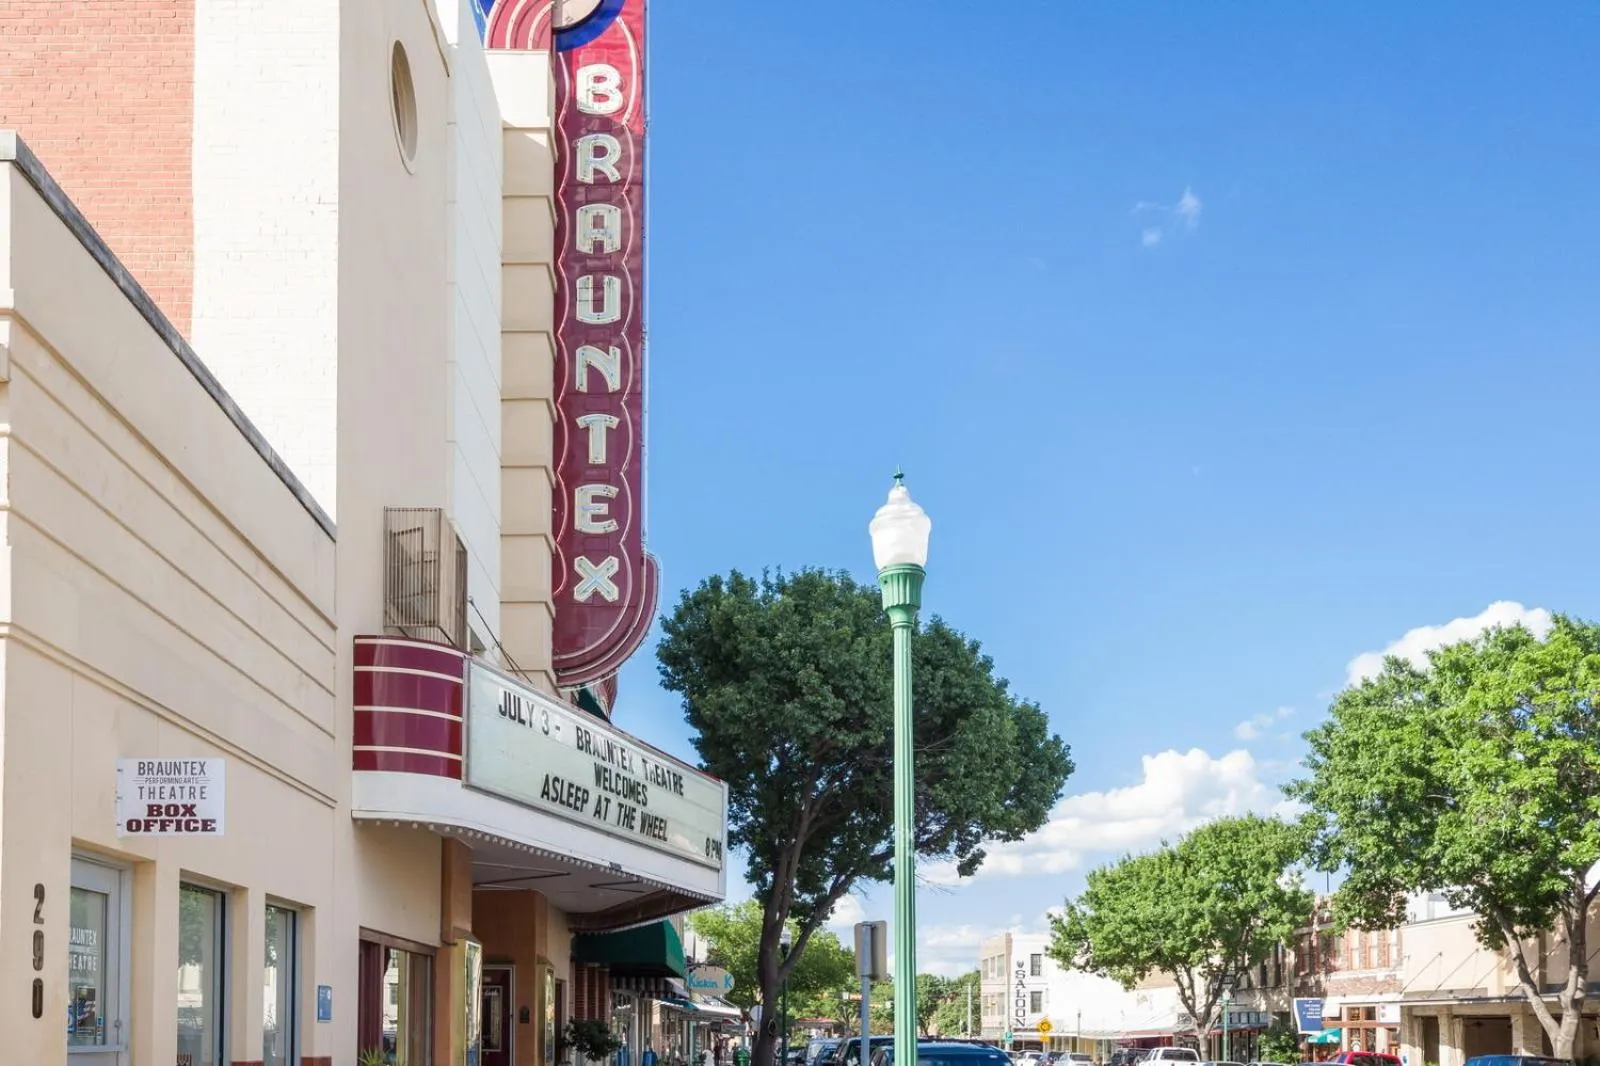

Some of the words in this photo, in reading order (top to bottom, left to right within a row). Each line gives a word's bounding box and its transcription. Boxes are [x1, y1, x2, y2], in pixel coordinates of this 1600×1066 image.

[573, 63, 623, 602] BRAUNTEX
[499, 691, 534, 728] JULY
[541, 710, 550, 736] 3
[576, 725, 635, 775] BRAUNTEX
[138, 761, 206, 776] BRAUNTEX
[138, 786, 207, 800] THEATRE
[594, 762, 648, 807] WELCOMES
[126, 819, 217, 832] OFFICE
[146, 804, 197, 817] BOX
[541, 774, 590, 813] ASLEEP
[593, 794, 611, 822] AT
[617, 802, 637, 830] THE
[640, 811, 668, 841] WHEEL
[32, 883, 45, 1018] 290
[1015, 969, 1026, 1027] SALOON
